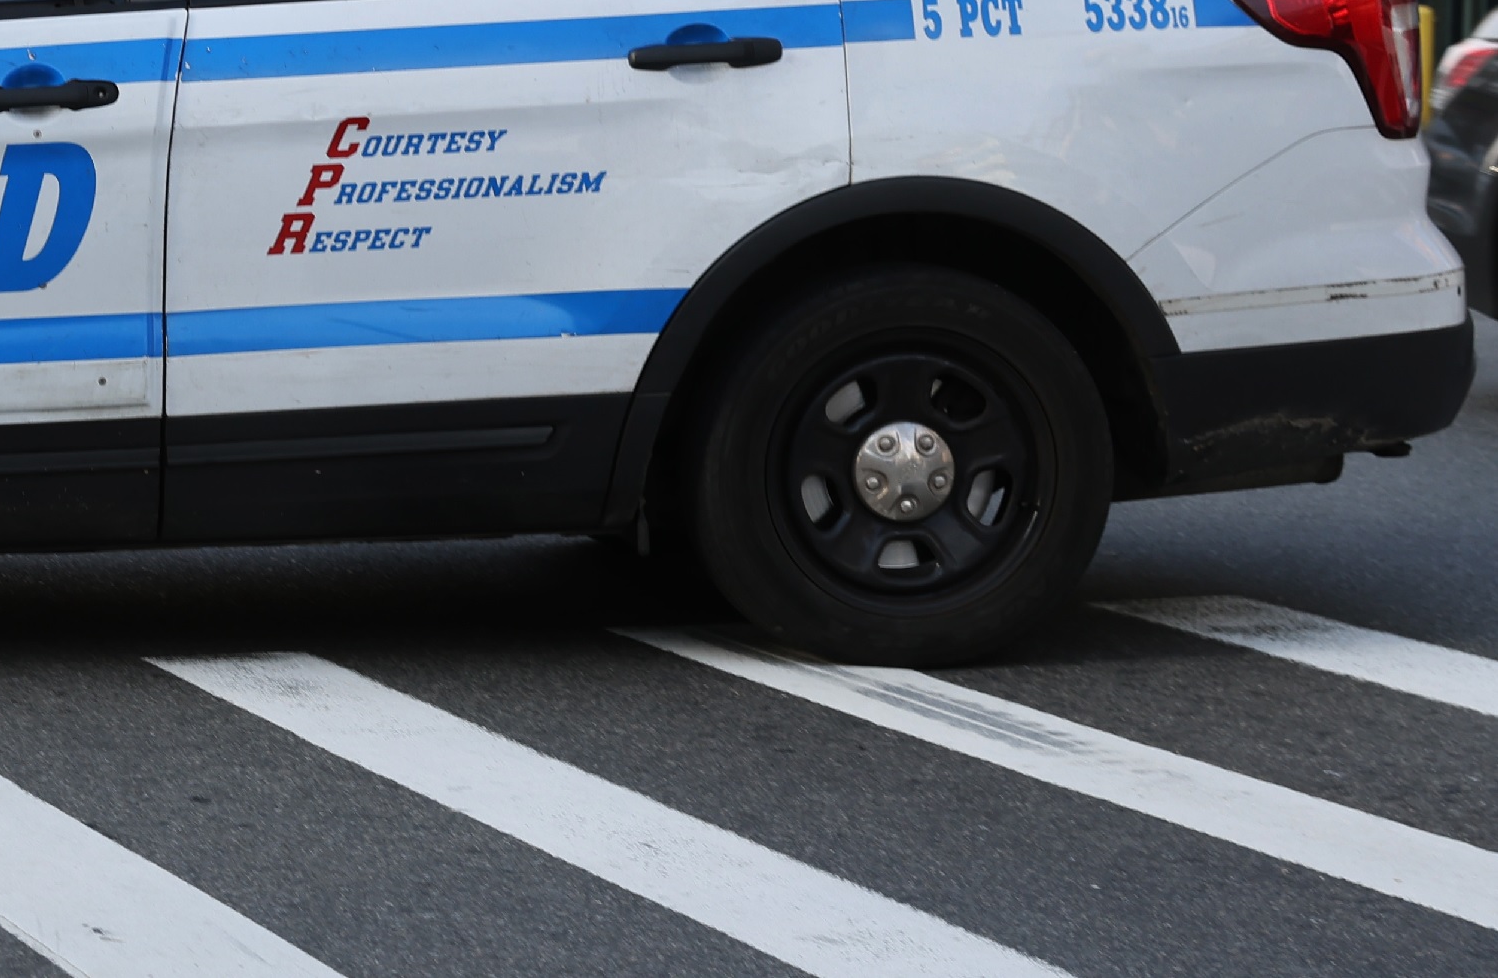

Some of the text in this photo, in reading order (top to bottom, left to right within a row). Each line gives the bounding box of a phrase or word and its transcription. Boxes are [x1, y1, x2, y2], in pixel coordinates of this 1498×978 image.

[326, 116, 508, 159] COURTESY
[297, 162, 607, 206] PROFESSIONALISM
[267, 212, 432, 255] RESPECT
